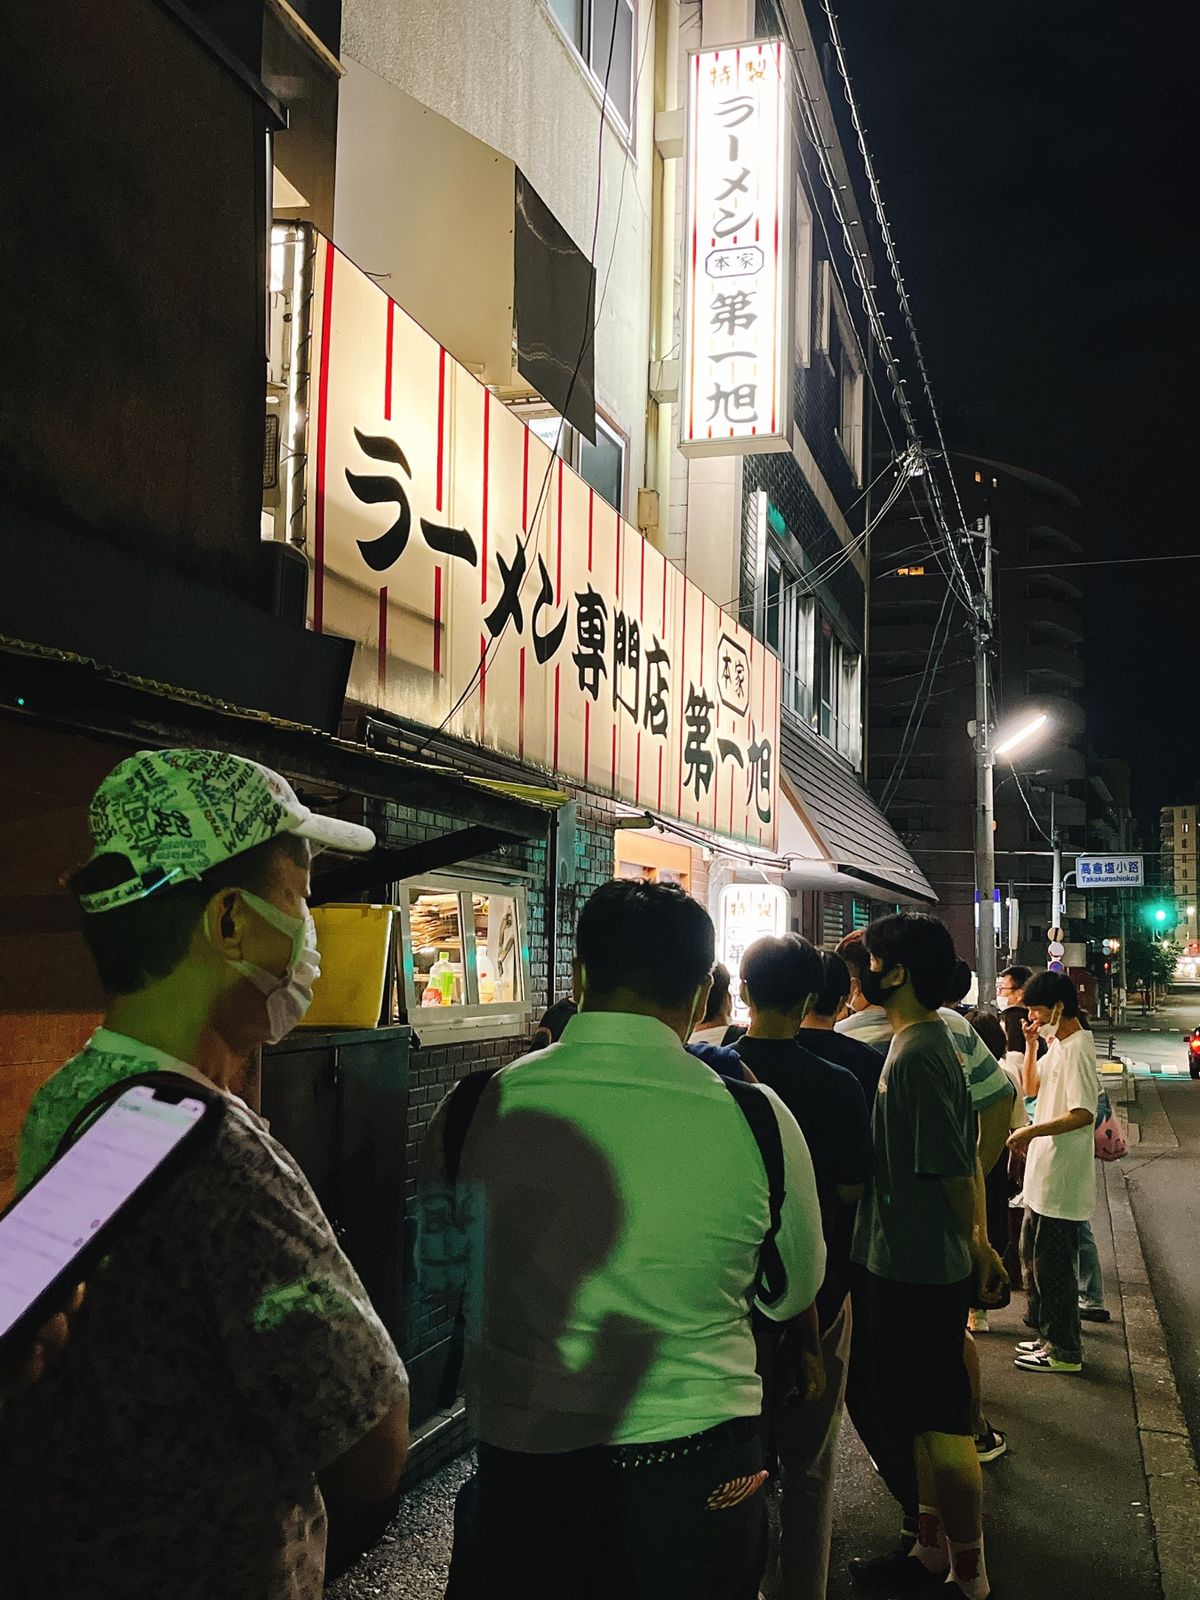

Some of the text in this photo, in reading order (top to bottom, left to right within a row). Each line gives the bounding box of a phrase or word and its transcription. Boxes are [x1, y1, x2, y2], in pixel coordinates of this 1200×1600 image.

[713, 95, 755, 240] ラーメン
[714, 252, 754, 272] 本家
[705, 289, 759, 423] 第一旭
[722, 651, 745, 699] 本家
[683, 680, 772, 823] 第一旭
[1081, 862, 1139, 874] 高倉塩小路
[1082, 875, 1140, 883] Takakurashiokoji
